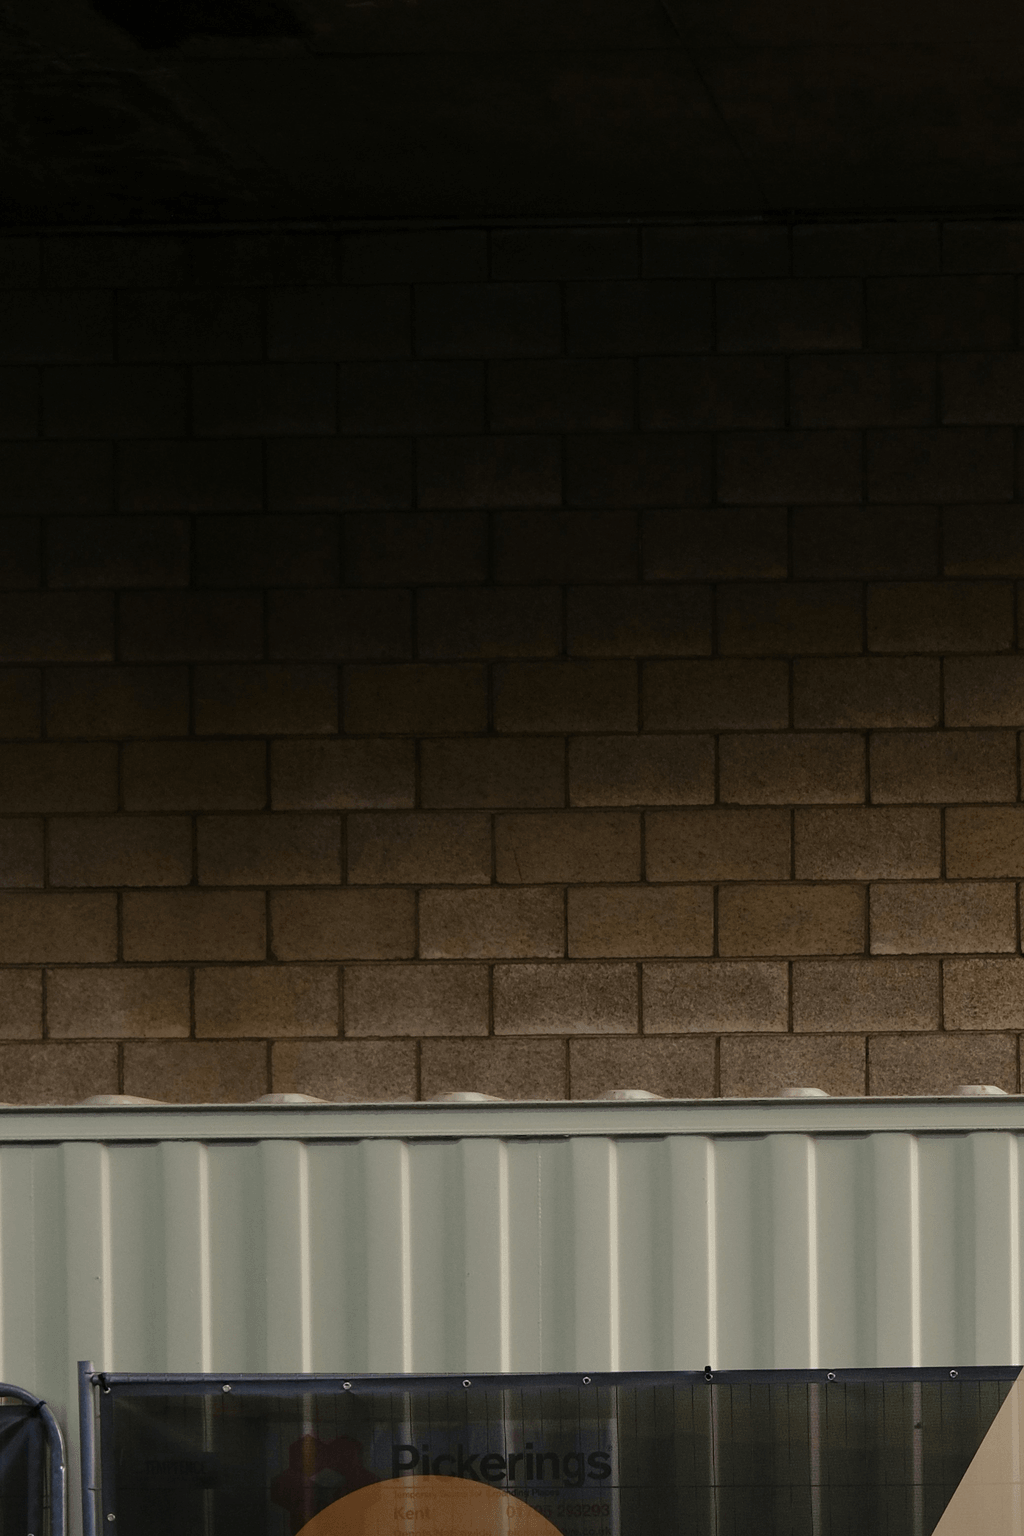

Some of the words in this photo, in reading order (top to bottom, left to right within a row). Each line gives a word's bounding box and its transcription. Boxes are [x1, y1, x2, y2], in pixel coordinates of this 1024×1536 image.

[392, 1443, 611, 1487] Pickerings
[393, 1507, 430, 1520] Kent
[557, 1503, 610, 1518] 293293
